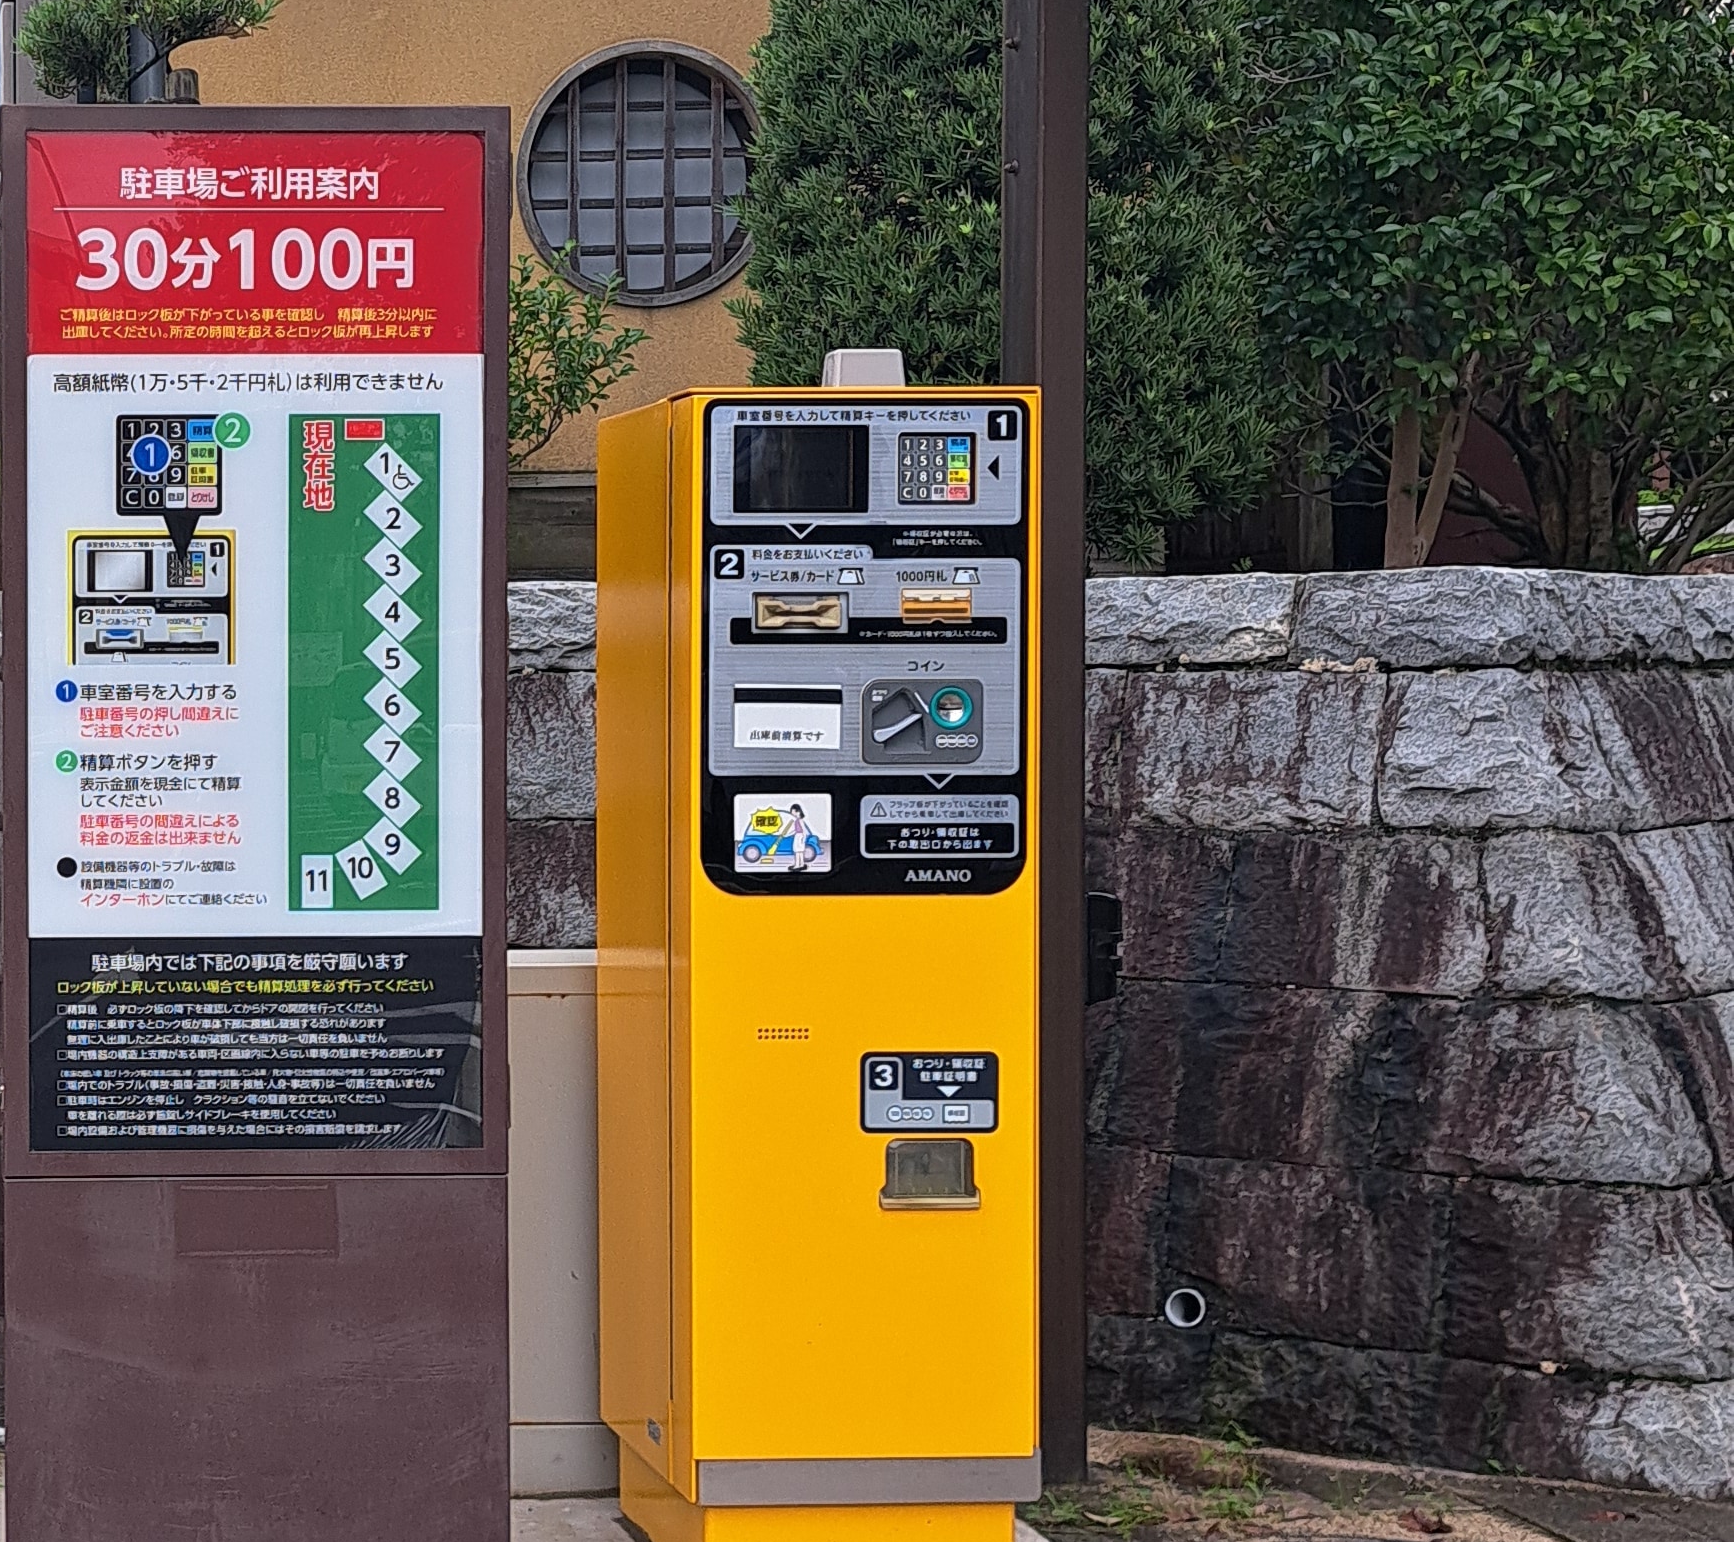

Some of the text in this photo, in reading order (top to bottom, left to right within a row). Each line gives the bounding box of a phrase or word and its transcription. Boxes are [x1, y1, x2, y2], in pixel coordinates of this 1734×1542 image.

[120, 167, 380, 201] 駐車場ご利用案内
[75, 227, 415, 290] 30分100円
[338, 308, 437, 322] 精算後3分以内に
[62, 325, 434, 339] 出庫してください。所定の時間を超えるとロック板が再上昇します
[170, 422, 182, 438] 3
[224, 418, 242, 443] 2
[996, 414, 1007, 437] 1
[171, 445, 182, 460] 6
[920, 439, 927, 450] 2
[936, 439, 944, 450] 3
[144, 442, 155, 467] 1
[380, 452, 389, 474] 1
[903, 455, 912, 466] 4
[920, 455, 927, 466] 5
[935, 455, 943, 466] 6
[303, 421, 334, 510] 現在地
[126, 468, 138, 482] 7
[170, 467, 182, 483] 9
[904, 471, 911, 483] 7
[920, 471, 927, 482] 8
[935, 471, 943, 482] 9
[126, 490, 139, 505] C
[903, 487, 912, 498] C
[384, 507, 401, 530] 2
[752, 549, 864, 561] 料金をお支払いください
[384, 554, 401, 577] 3
[719, 553, 740, 576] 2
[896, 570, 947, 582] 1000円札
[384, 601, 401, 623] 4
[385, 648, 401, 670] 5
[908, 660, 945, 672] コイン
[80, 684, 237, 701] 車室番号を入力する
[384, 694, 400, 716] 6
[80, 707, 239, 722] 駐車番号の押し間違えに
[81, 724, 179, 738] ご注意ください
[384, 741, 401, 763] 7
[80, 754, 218, 771] 精算ボタンを押す
[81, 777, 241, 791] 表示金額を現金にて精算
[81, 795, 163, 807] してください
[384, 787, 400, 809] 8
[80, 815, 240, 829] 駐車番号の間違えによる
[80, 831, 241, 846] 料金の返金は出来ません
[384, 833, 401, 855] 9
[347, 856, 374, 879] 10
[904, 869, 972, 882] AMANO
[305, 869, 328, 892] 11
[92, 953, 409, 972] 駐車場内では下記の事項を厳守願います
[57, 980, 434, 994] ロック板が上昇していない場合でも精算処理を必ず行ってください
[874, 1064, 893, 1087] 3
